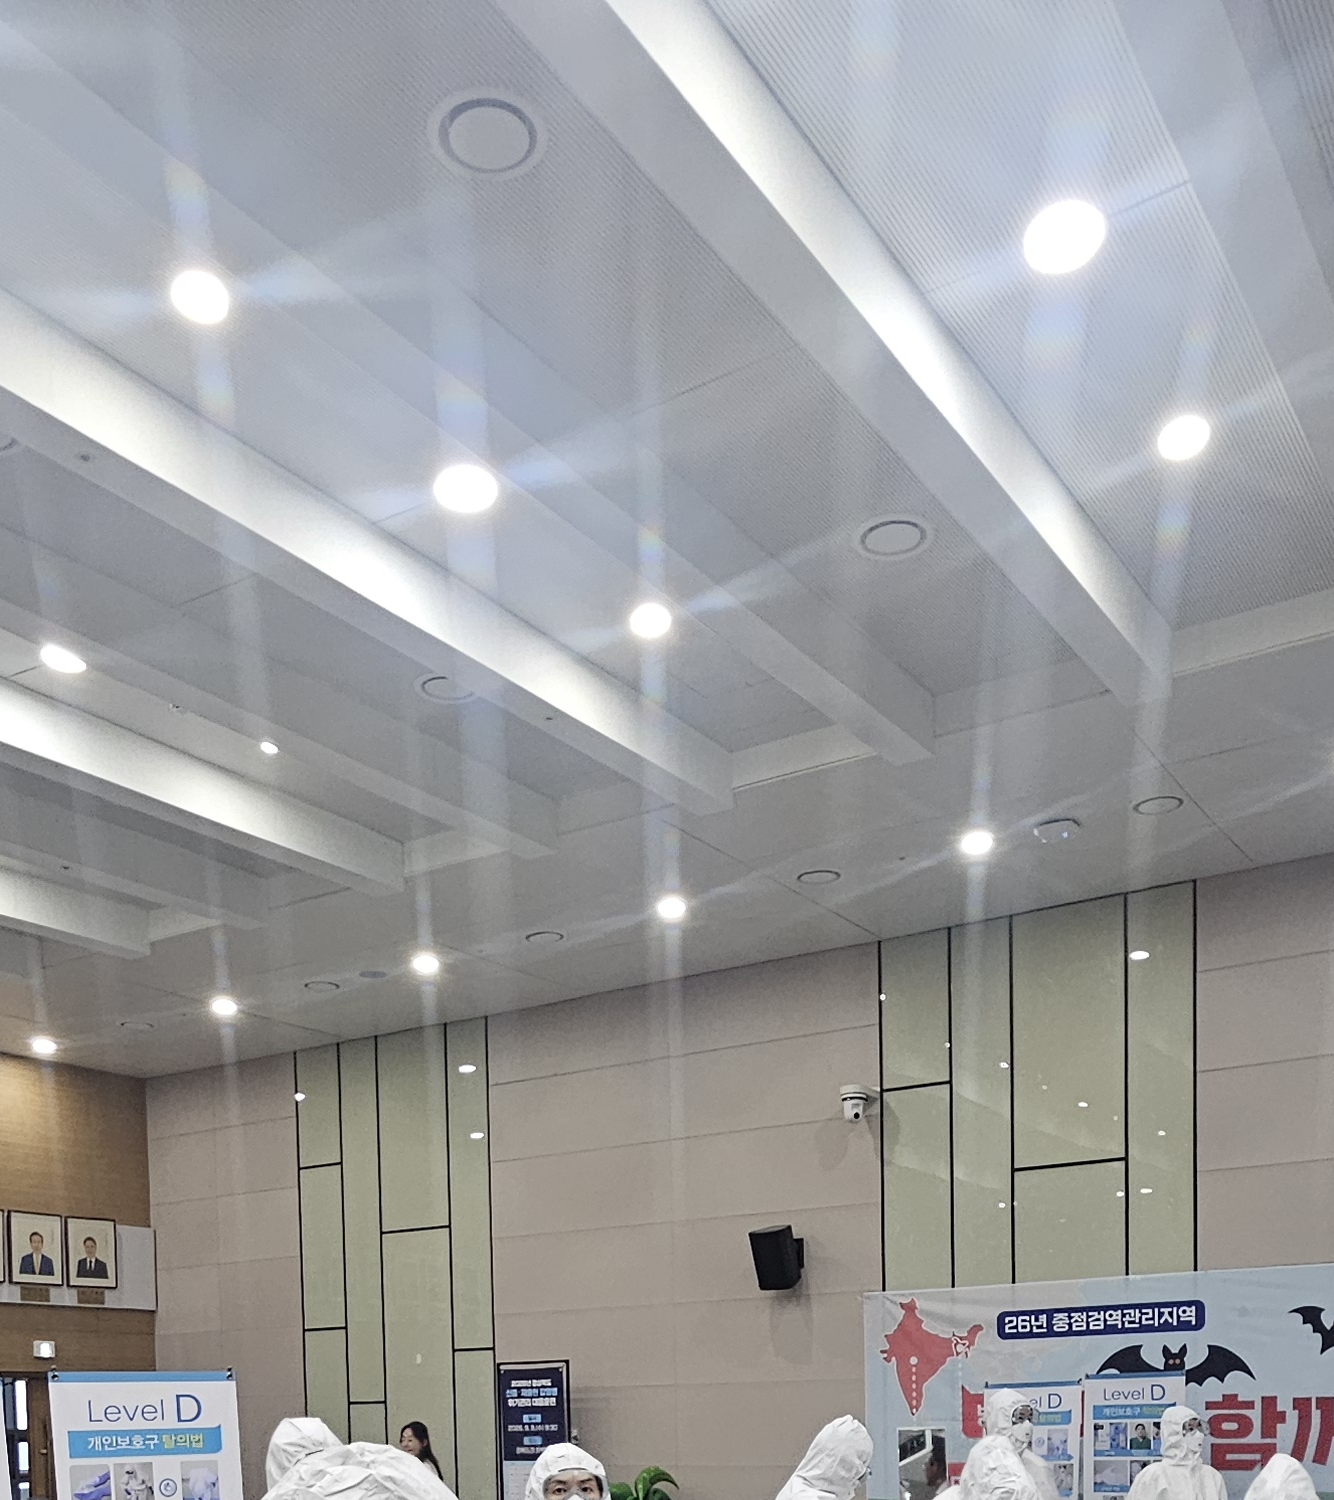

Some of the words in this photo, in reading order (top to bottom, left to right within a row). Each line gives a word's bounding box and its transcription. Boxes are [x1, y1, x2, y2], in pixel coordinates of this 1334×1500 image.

[1004, 1314, 1047, 1334] 26년
[1052, 1305, 1197, 1331] 중점검역관리지역
[1048, 1393, 1062, 1409] D
[1103, 1387, 1146, 1401] Level
[1151, 1384, 1166, 1401] D
[88, 1399, 165, 1423] Level
[176, 1394, 202, 1423] D
[87, 1434, 160, 1451] 개인보호구
[162, 1433, 204, 1449] 탈의법
